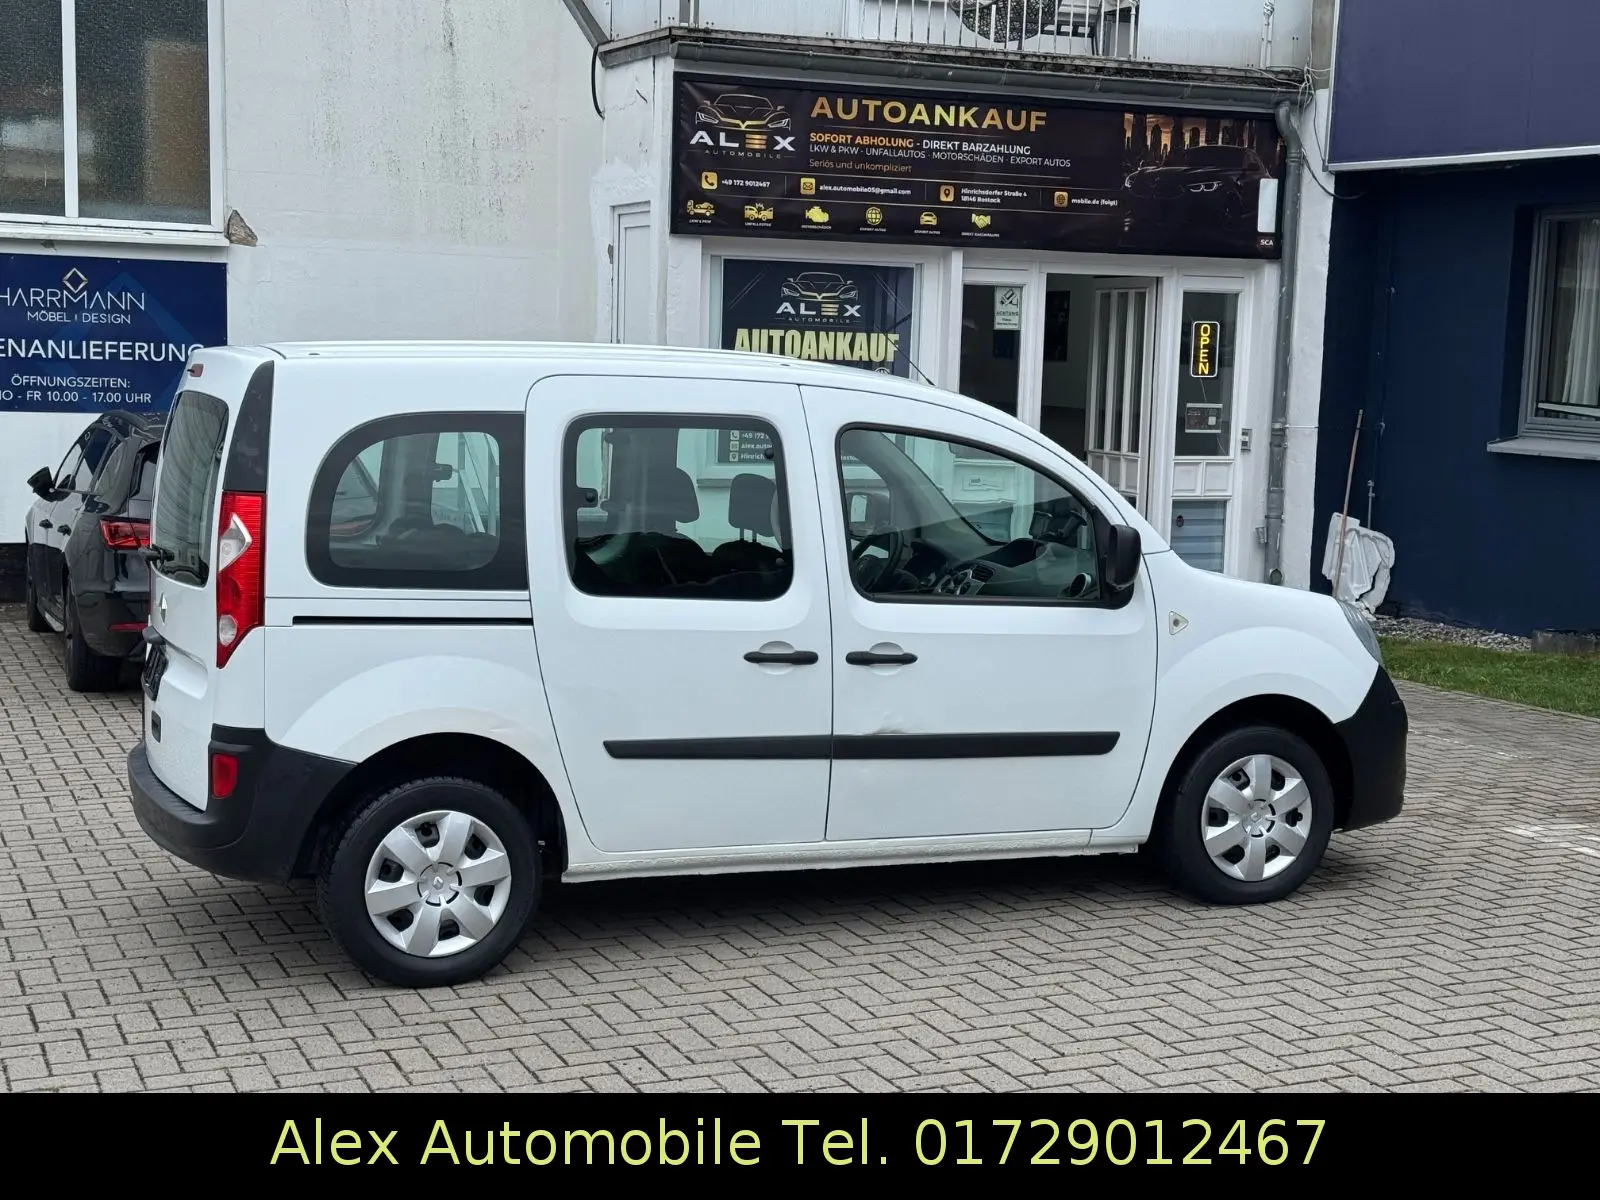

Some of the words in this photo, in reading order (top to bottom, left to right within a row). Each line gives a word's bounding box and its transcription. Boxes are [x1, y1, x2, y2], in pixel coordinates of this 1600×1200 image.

[811, 96, 1047, 132] AUTOANKAUF
[704, 149, 781, 159] AUTOMOBILE
[810, 132, 852, 144] SOFORT
[855, 135, 914, 148] ABHOLUNG
[922, 139, 960, 150] DIREKT
[962, 142, 1031, 155] BARZAHLUNG
[809, 144, 829, 153] LKW
[830, 145, 837, 154] &
[838, 145, 859, 155] PKW
[865, 147, 926, 159] UNFALLAUTOS
[932, 151, 1004, 163] MOTORSCHÄDEN
[1010, 156, 1041, 166] EXPORT
[1043, 158, 1071, 168] AUTOS
[809, 159, 834, 168] Seriös
[835, 161, 853, 169] und
[854, 162, 912, 172] unkompliziert
[0, 287, 145, 311] HARRMANN
[27, 310, 71, 322] MÖBEL
[82, 313, 131, 324] DESIGN
[0, 338, 204, 362] NANLIEFERUN
[734, 328, 899, 362] AUTOANKAUF
[1198, 323, 1211, 375] OPEN
[11, 373, 131, 388] ÖFFNUNGSZEITEN:
[0, 390, 13, 401] O
[26, 390, 42, 401] FR
[46, 391, 79, 402] 10.00
[93, 392, 122, 403] 17.00
[125, 393, 152, 403] UHR
